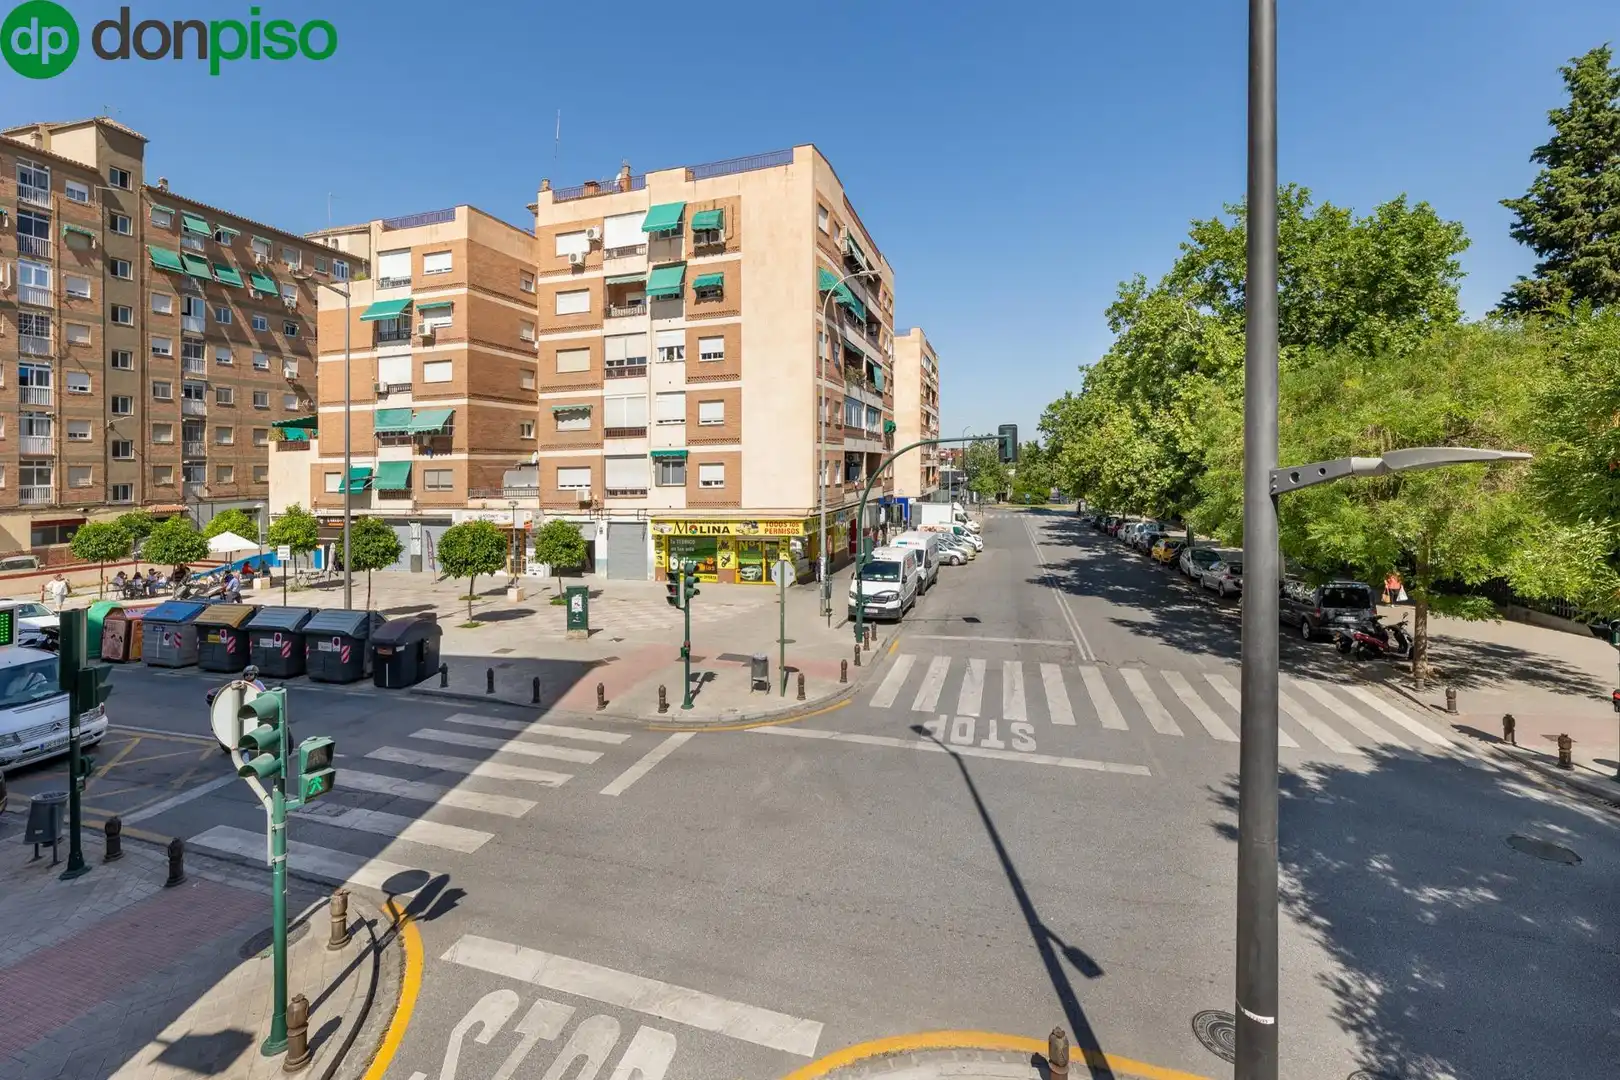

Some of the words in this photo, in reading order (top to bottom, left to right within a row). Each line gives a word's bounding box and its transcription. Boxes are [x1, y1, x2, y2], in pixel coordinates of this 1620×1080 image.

[673, 520, 731, 535] MOLINA
[764, 527, 800, 535] PERMISOS
[679, 556, 697, 570] ds
[920, 714, 1037, 752] STOP
